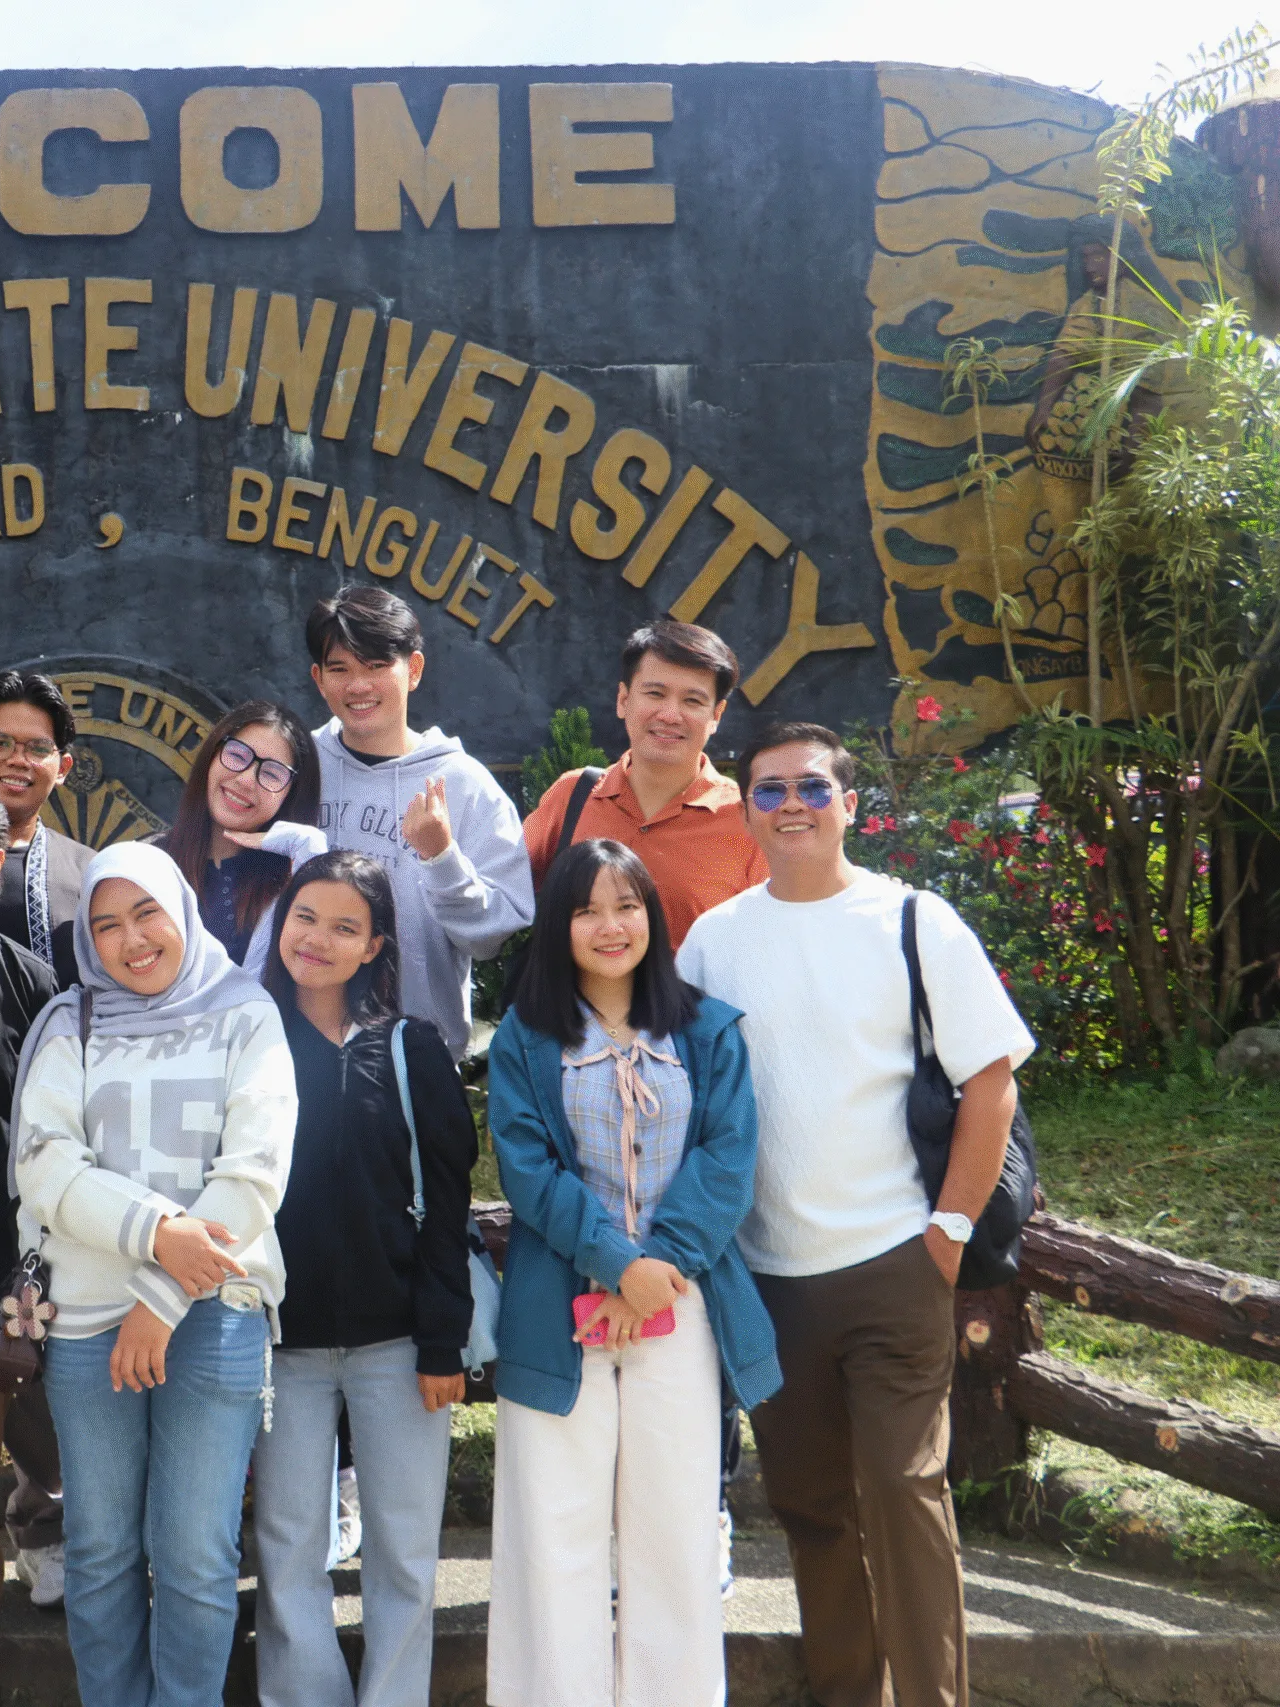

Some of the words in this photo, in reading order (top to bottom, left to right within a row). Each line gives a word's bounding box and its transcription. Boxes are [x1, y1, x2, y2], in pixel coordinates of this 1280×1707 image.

[183, 282, 877, 707] UNIVERSITY
[226, 466, 556, 644] BENGUET
[318, 799, 352, 831] DY
